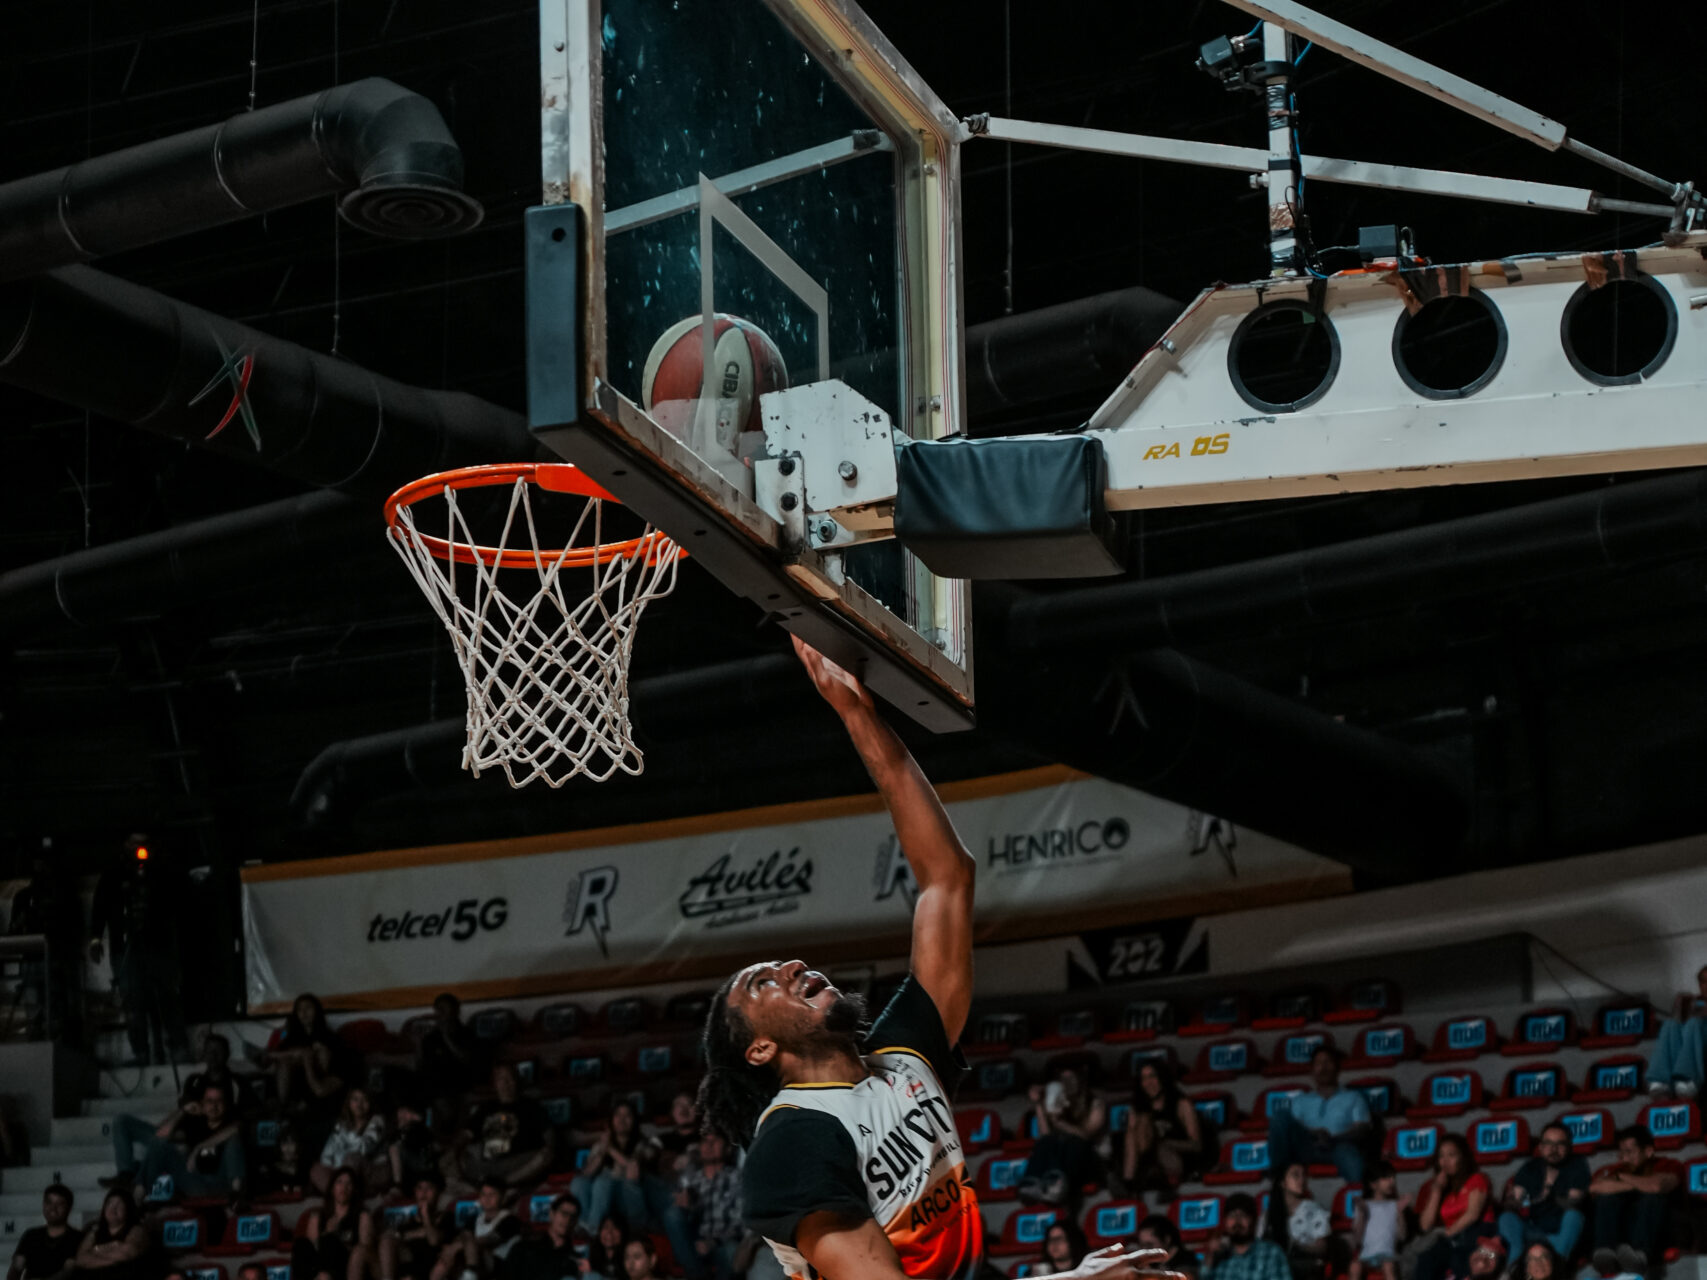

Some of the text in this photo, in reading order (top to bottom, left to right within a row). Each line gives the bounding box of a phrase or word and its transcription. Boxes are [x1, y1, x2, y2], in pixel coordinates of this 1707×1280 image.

[988, 817, 1130, 867] HENRICO
[866, 1125, 925, 1200] SUN
[911, 1178, 961, 1232] ARCO
